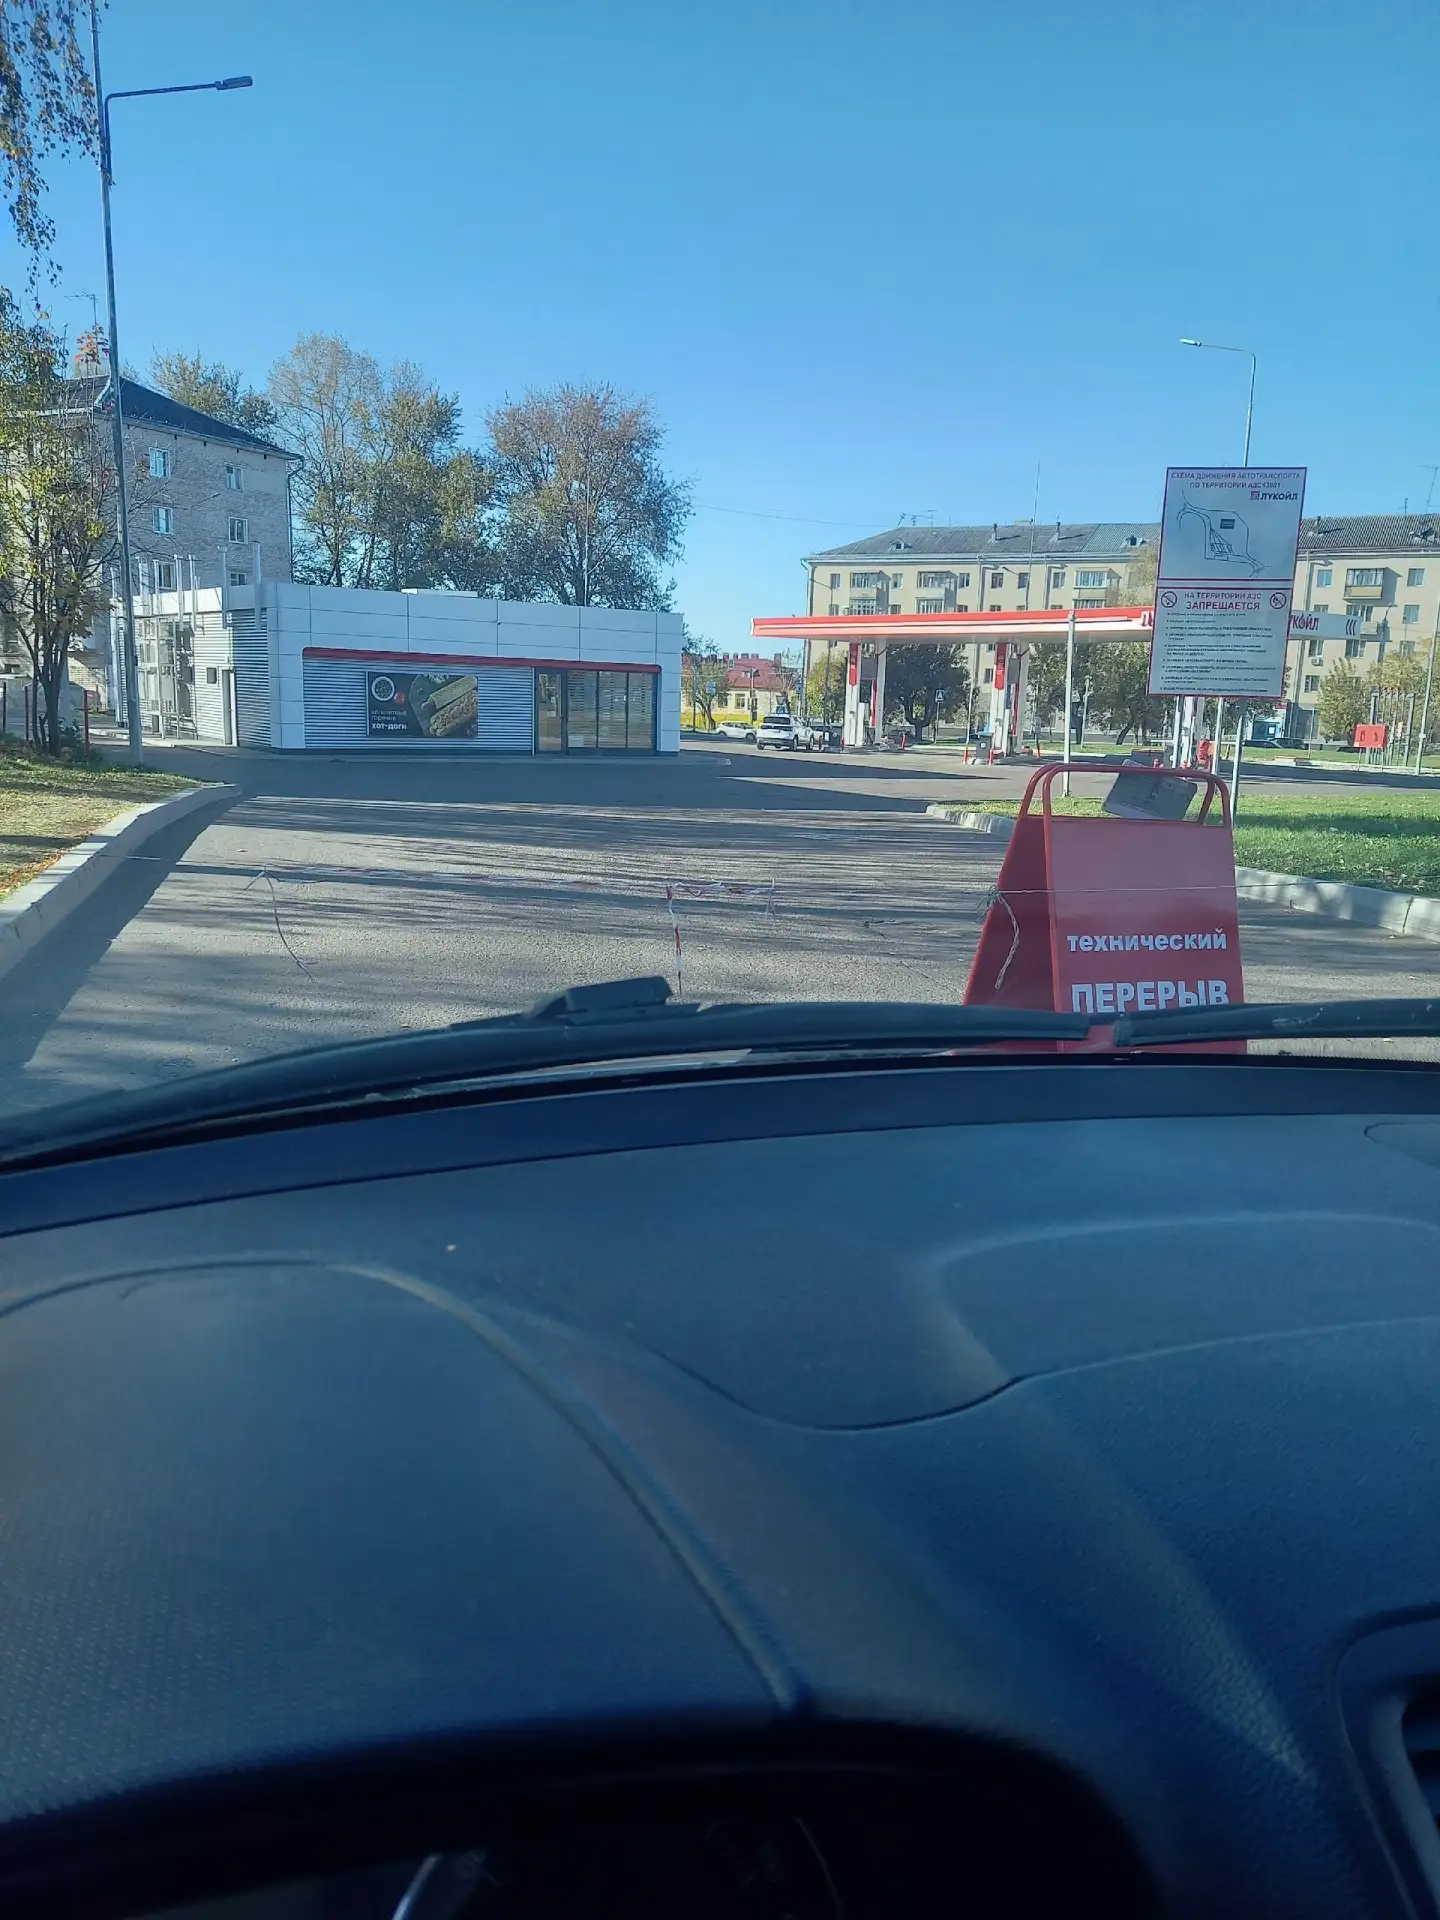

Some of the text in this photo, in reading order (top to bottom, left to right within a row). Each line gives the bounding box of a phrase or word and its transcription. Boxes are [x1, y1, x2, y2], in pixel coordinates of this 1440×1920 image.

[1260, 491, 1298, 501] ЛУКОЙЛ
[1197, 592, 1246, 600] ТЕРРИТОРИИ
[1186, 601, 1260, 611] ЗАПРЕЩАЕТСЯ
[371, 722, 407, 730] хот-доги
[1067, 928, 1227, 952] технический
[1071, 980, 1230, 1014] ПЕРЕРЫВ
